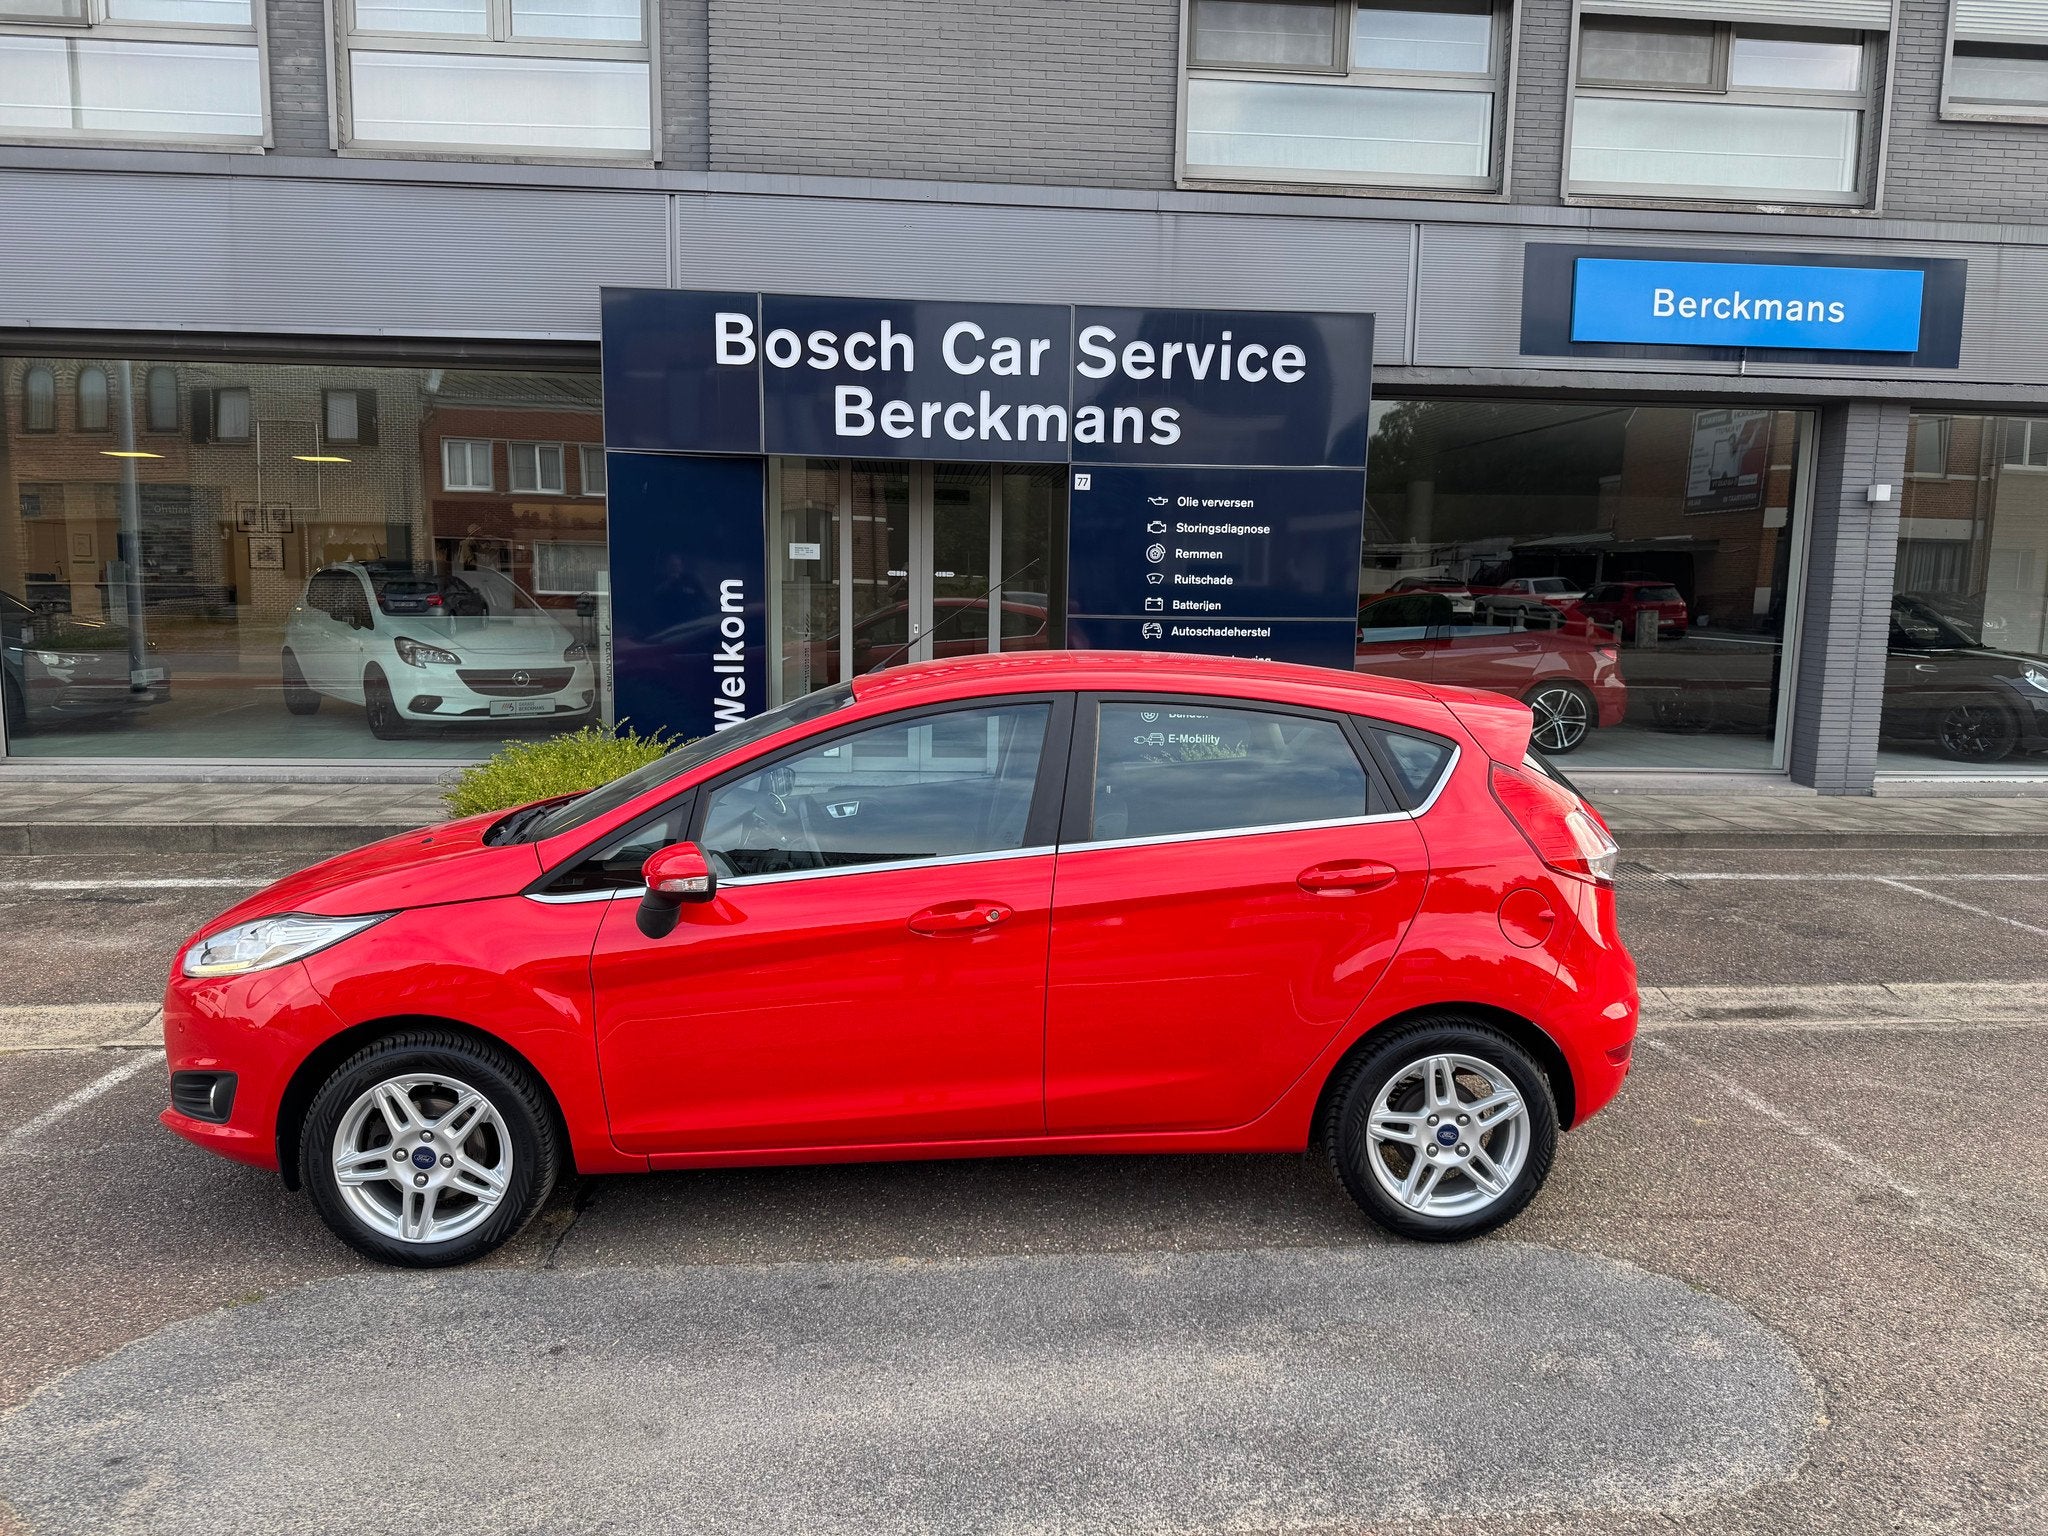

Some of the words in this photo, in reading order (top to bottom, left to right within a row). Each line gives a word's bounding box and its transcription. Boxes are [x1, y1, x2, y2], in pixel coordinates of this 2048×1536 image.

[1653, 288, 1845, 323] Berckmans
[715, 312, 915, 373] Bosch
[942, 321, 1051, 376] Car
[1076, 325, 1307, 384] Service
[834, 385, 1182, 447] Berckmans
[1077, 477, 1088, 486] 77
[1176, 496, 1199, 508] Olie
[1201, 499, 1254, 509] verversen
[1175, 522, 1271, 536] Storingsdiagnose
[1175, 548, 1223, 560] Remmen
[1173, 574, 1234, 586] Ruitschade
[1172, 600, 1222, 612] Batterijen
[1170, 625, 1271, 638] Autoschadeherstel
[713, 579, 746, 732] Welkom
[1168, 733, 1221, 746] E-Mobility
